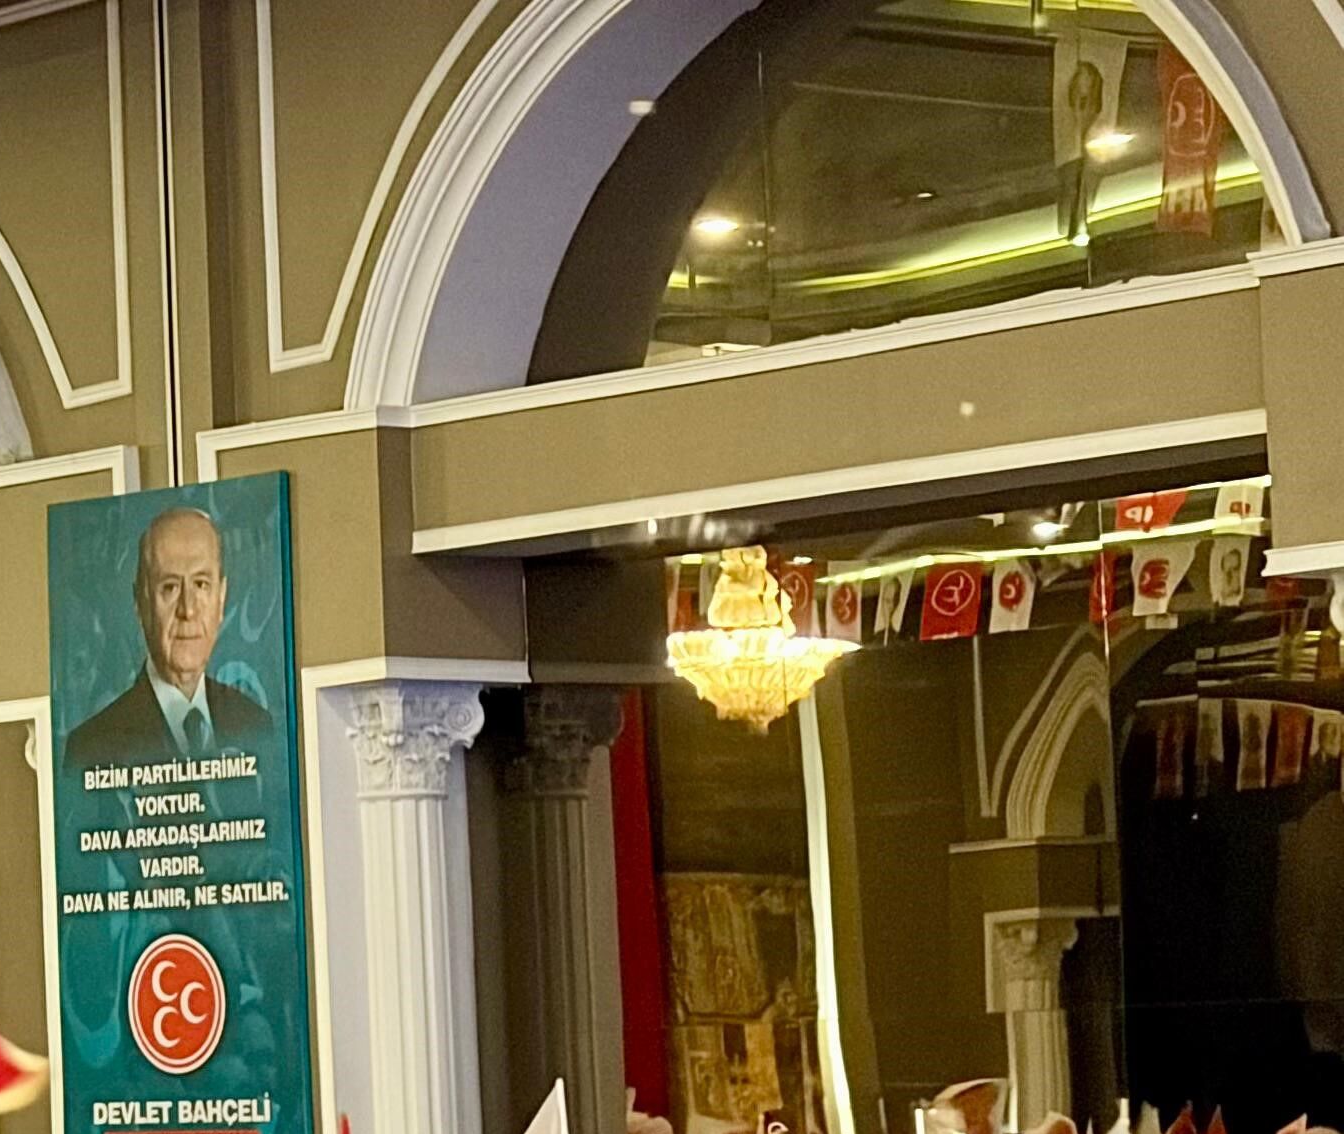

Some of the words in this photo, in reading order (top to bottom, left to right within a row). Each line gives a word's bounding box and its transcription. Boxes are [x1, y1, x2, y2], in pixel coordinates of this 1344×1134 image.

[85, 764, 128, 790] BİZİM
[132, 752, 257, 786] PARTİLİLERİMİZ
[135, 793, 205, 816] YOKTUR.
[81, 830, 122, 852] DAVA
[125, 819, 266, 849] ARKADAŞLARIMIZ
[140, 855, 204, 878] VARDIR.
[63, 893, 104, 914] DAVA
[108, 891, 129, 910] NE
[133, 887, 191, 910] ALINIR,
[195, 885, 218, 906] NE
[222, 881, 289, 904] SATILIR.
[93, 1101, 172, 1125] DEVLET
[178, 1092, 271, 1126] BAHÇELİ
